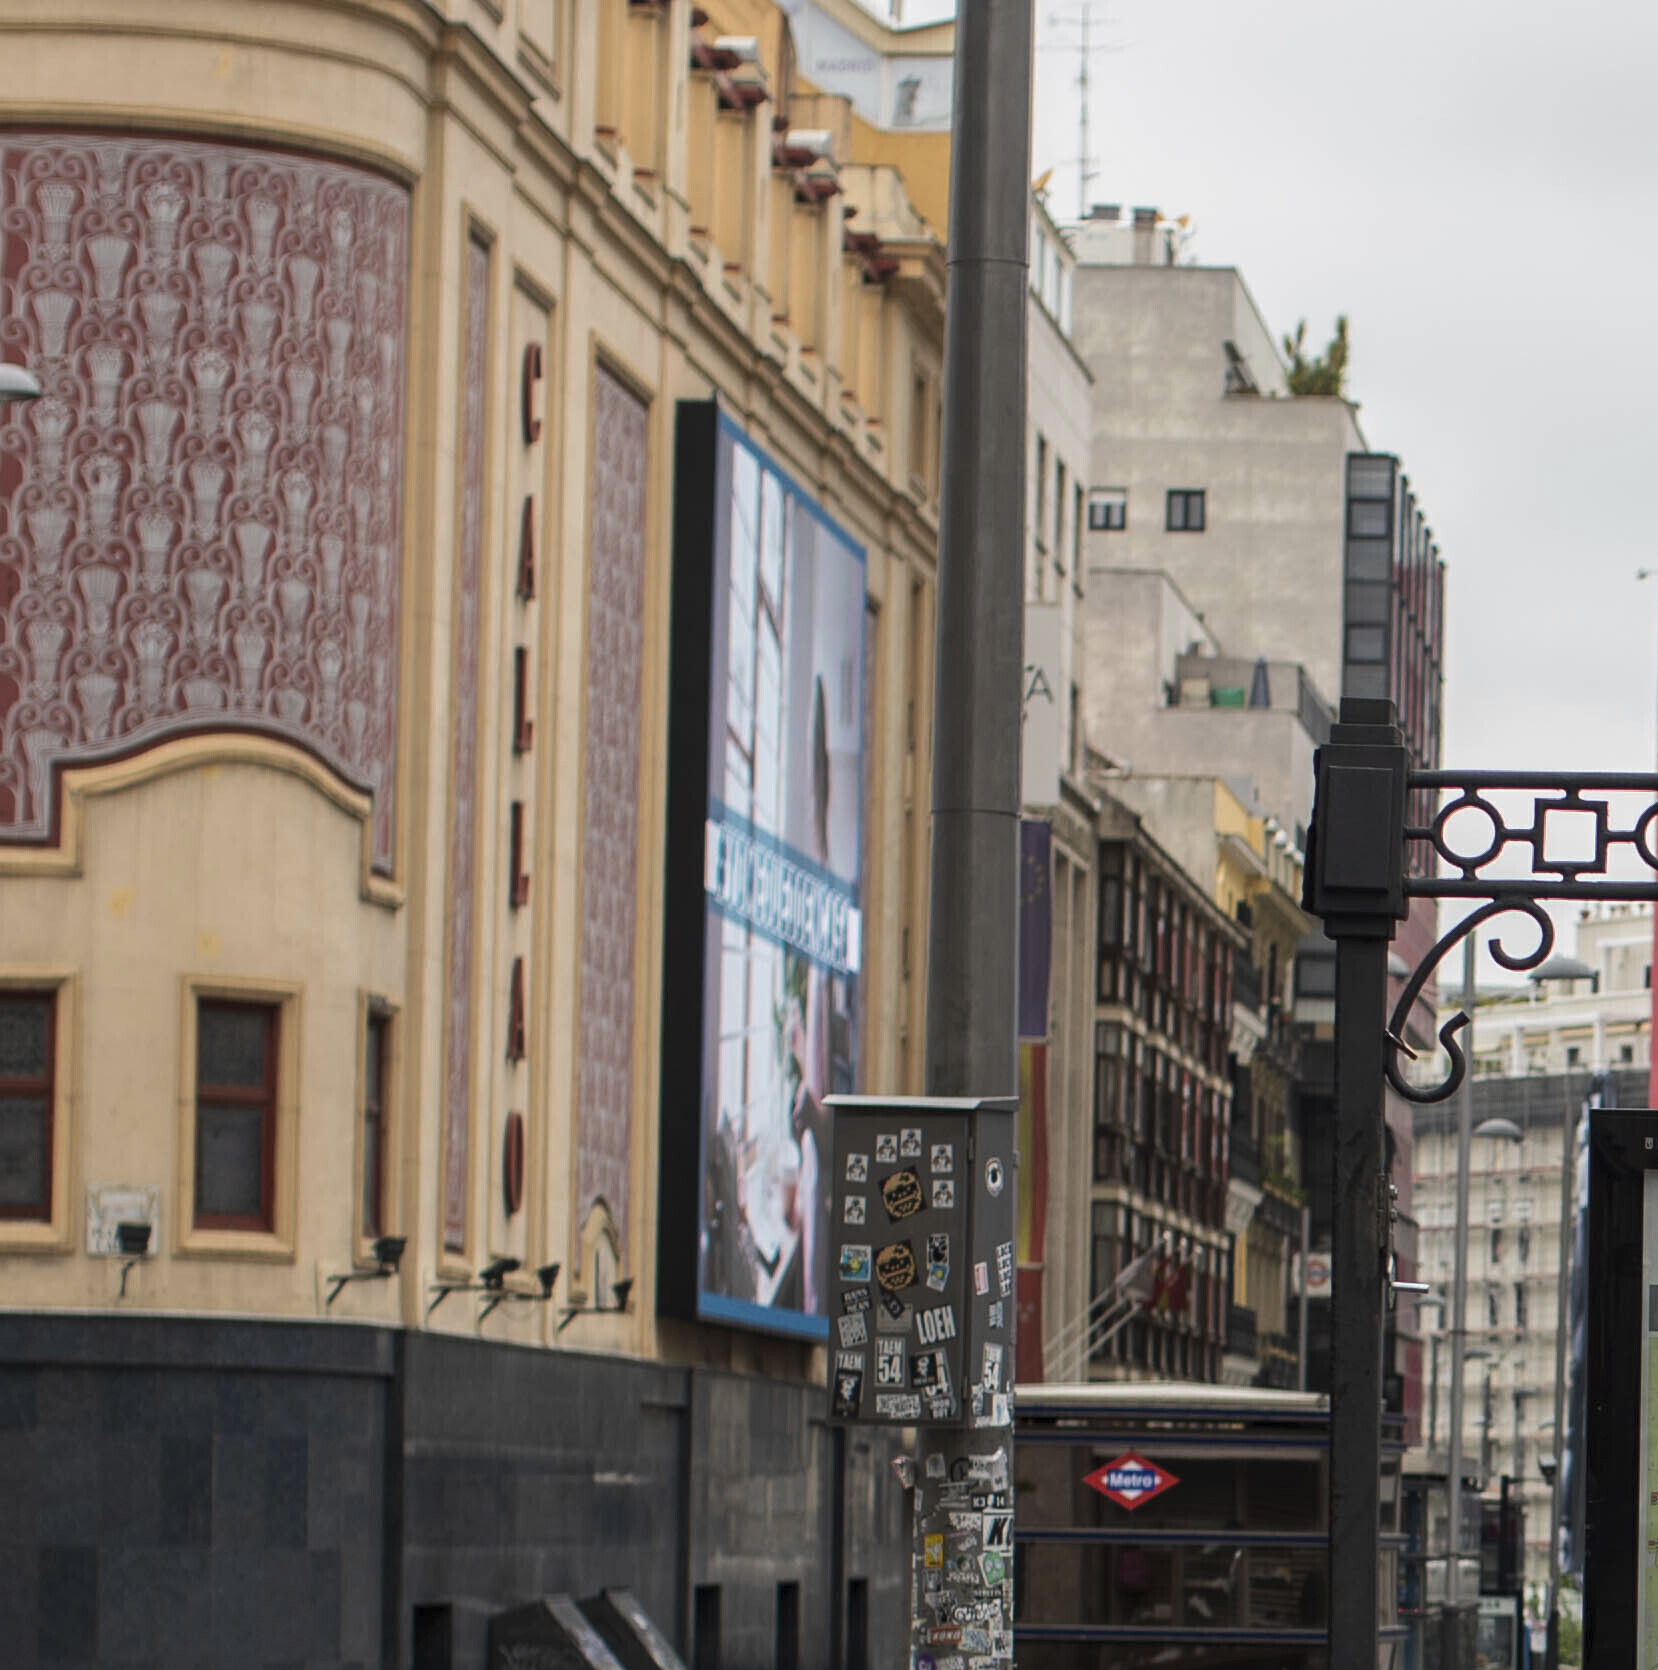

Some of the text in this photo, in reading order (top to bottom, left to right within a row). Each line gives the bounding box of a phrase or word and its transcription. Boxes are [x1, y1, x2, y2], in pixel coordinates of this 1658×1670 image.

[503, 340, 542, 1216] CALLAO
[877, 1355, 903, 1384] 54
[1109, 1472, 1152, 1488] Metro
